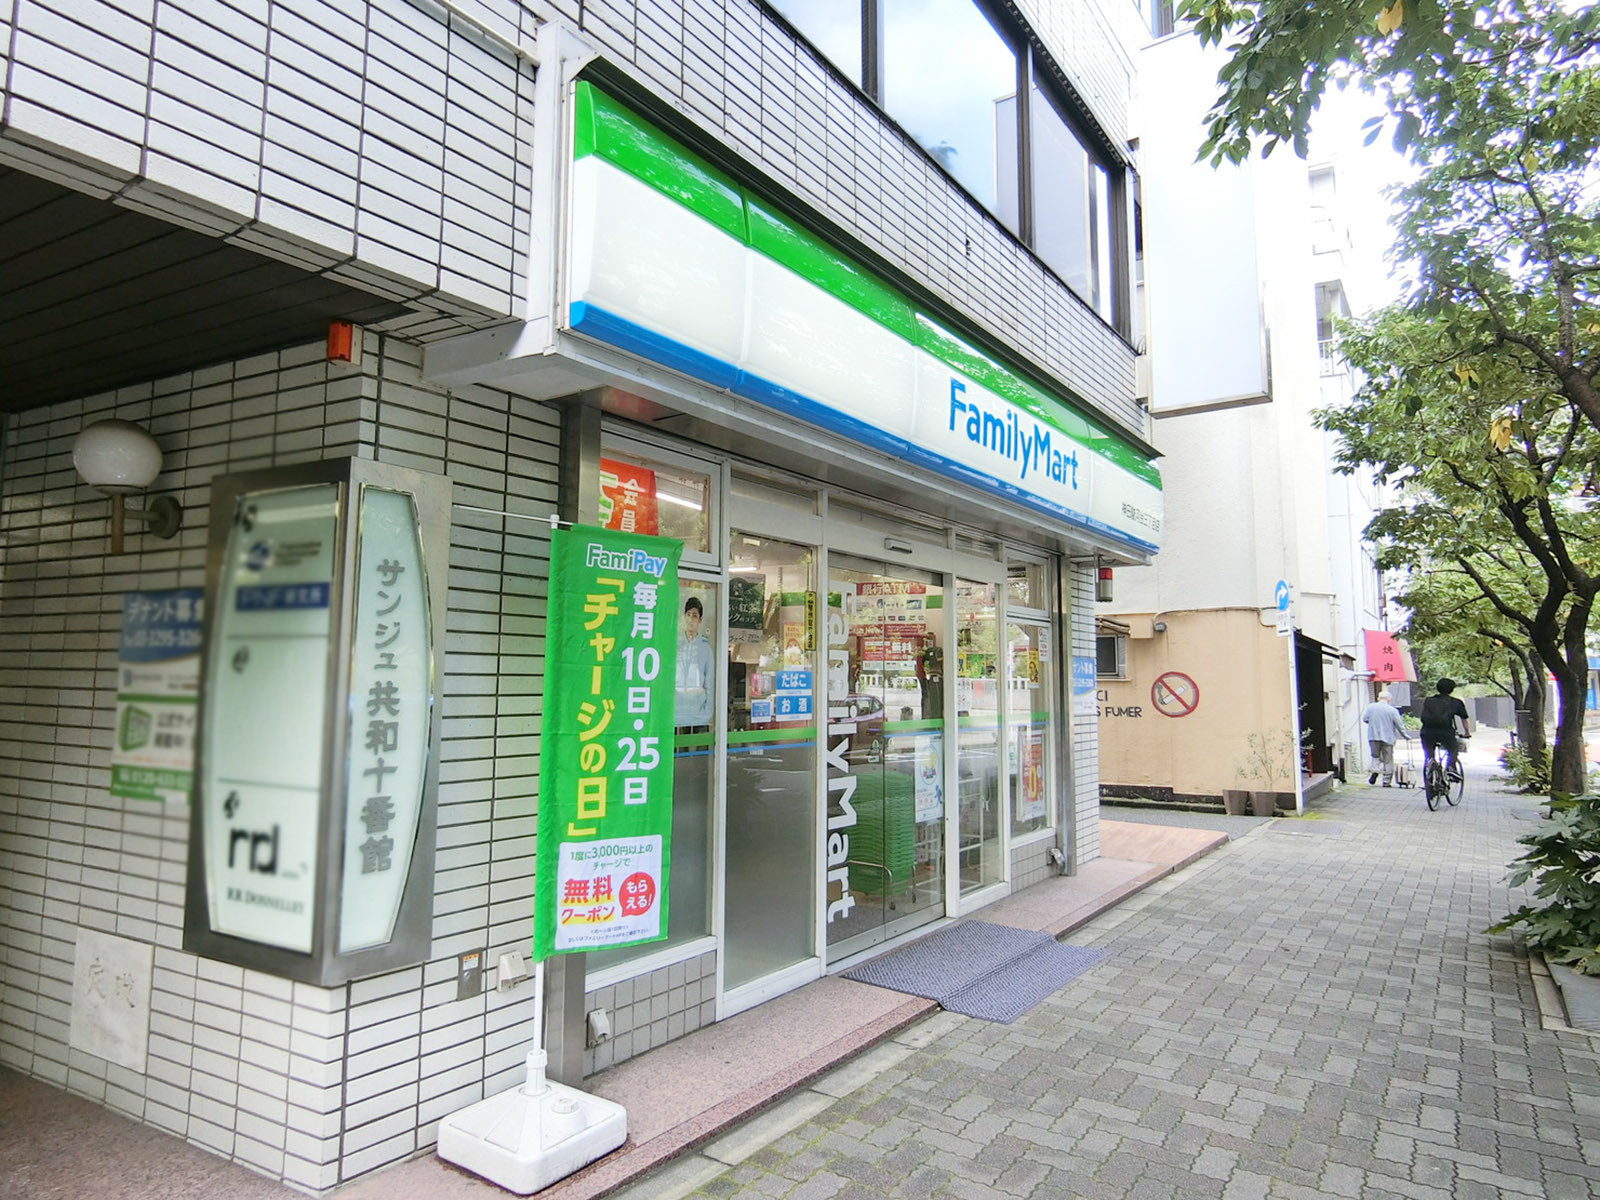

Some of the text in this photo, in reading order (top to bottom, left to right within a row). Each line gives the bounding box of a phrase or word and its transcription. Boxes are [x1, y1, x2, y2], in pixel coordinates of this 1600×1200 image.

[949, 378, 1078, 490] FamilyMart
[586, 543, 667, 577] FamiPay
[1383, 645, 1393, 671] 焼肉
[782, 673, 806, 688] たばこ
[360, 558, 405, 875] サンジュ共和十番館
[1105, 706, 1142, 718] FUMER
[593, 858, 631, 871] チャージで
[564, 875, 613, 904] 無料
[626, 879, 648, 894] もら
[561, 906, 615, 925] クーポン
